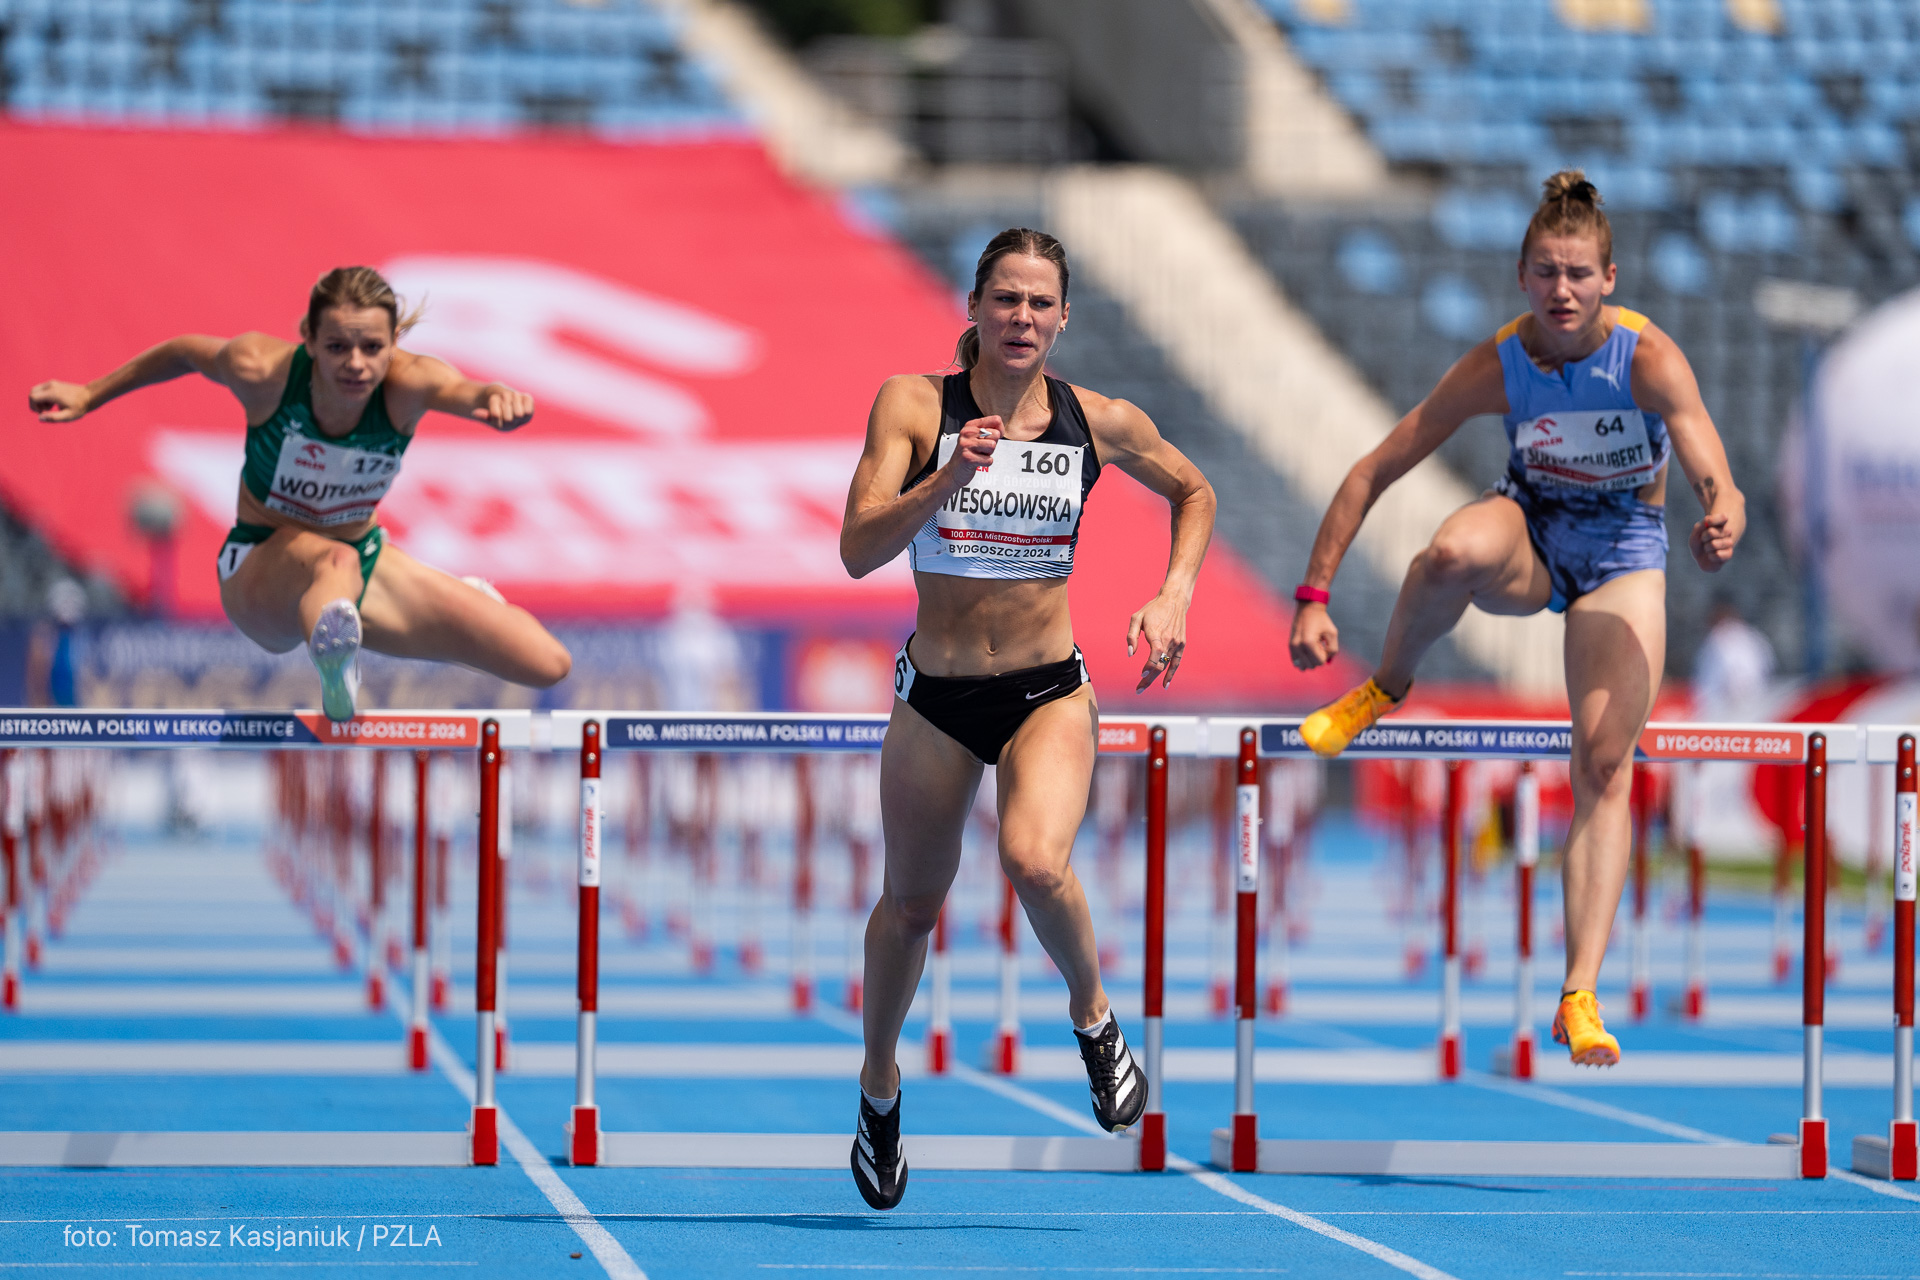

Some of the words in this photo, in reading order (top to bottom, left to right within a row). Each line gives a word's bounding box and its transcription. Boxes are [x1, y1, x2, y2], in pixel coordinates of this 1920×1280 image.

[1595, 415, 1625, 436] 64
[1021, 450, 1070, 476] 160
[951, 530, 965, 539] 100.
[966, 531, 983, 540] PZLA
[984, 532, 1031, 544] Mistrzostwa
[1032, 536, 1053, 544] Polski
[949, 544, 1023, 558] BYDGOSZCZ
[1023, 548, 1051, 558] 2024
[895, 655, 907, 693] 6
[0, 719, 93, 735] ISTRZOSTWA
[97, 720, 150, 735] POLSKI
[153, 720, 169, 735] W
[173, 720, 294, 737] LEKKOATLETYCE
[331, 720, 426, 738] BYDGOSZCZ
[429, 723, 467, 739] 2024
[626, 724, 658, 741] 100.
[661, 724, 768, 741] MISTRZOSTWA
[770, 724, 823, 742] POLSKI
[826, 725, 843, 741] W
[1099, 729, 1136, 745] 2024
[1425, 730, 1479, 747] POLSKI
[1481, 731, 1497, 747] W
[1656, 735, 1752, 753] BYDGOSZCZ
[1754, 738, 1791, 754] 2024
